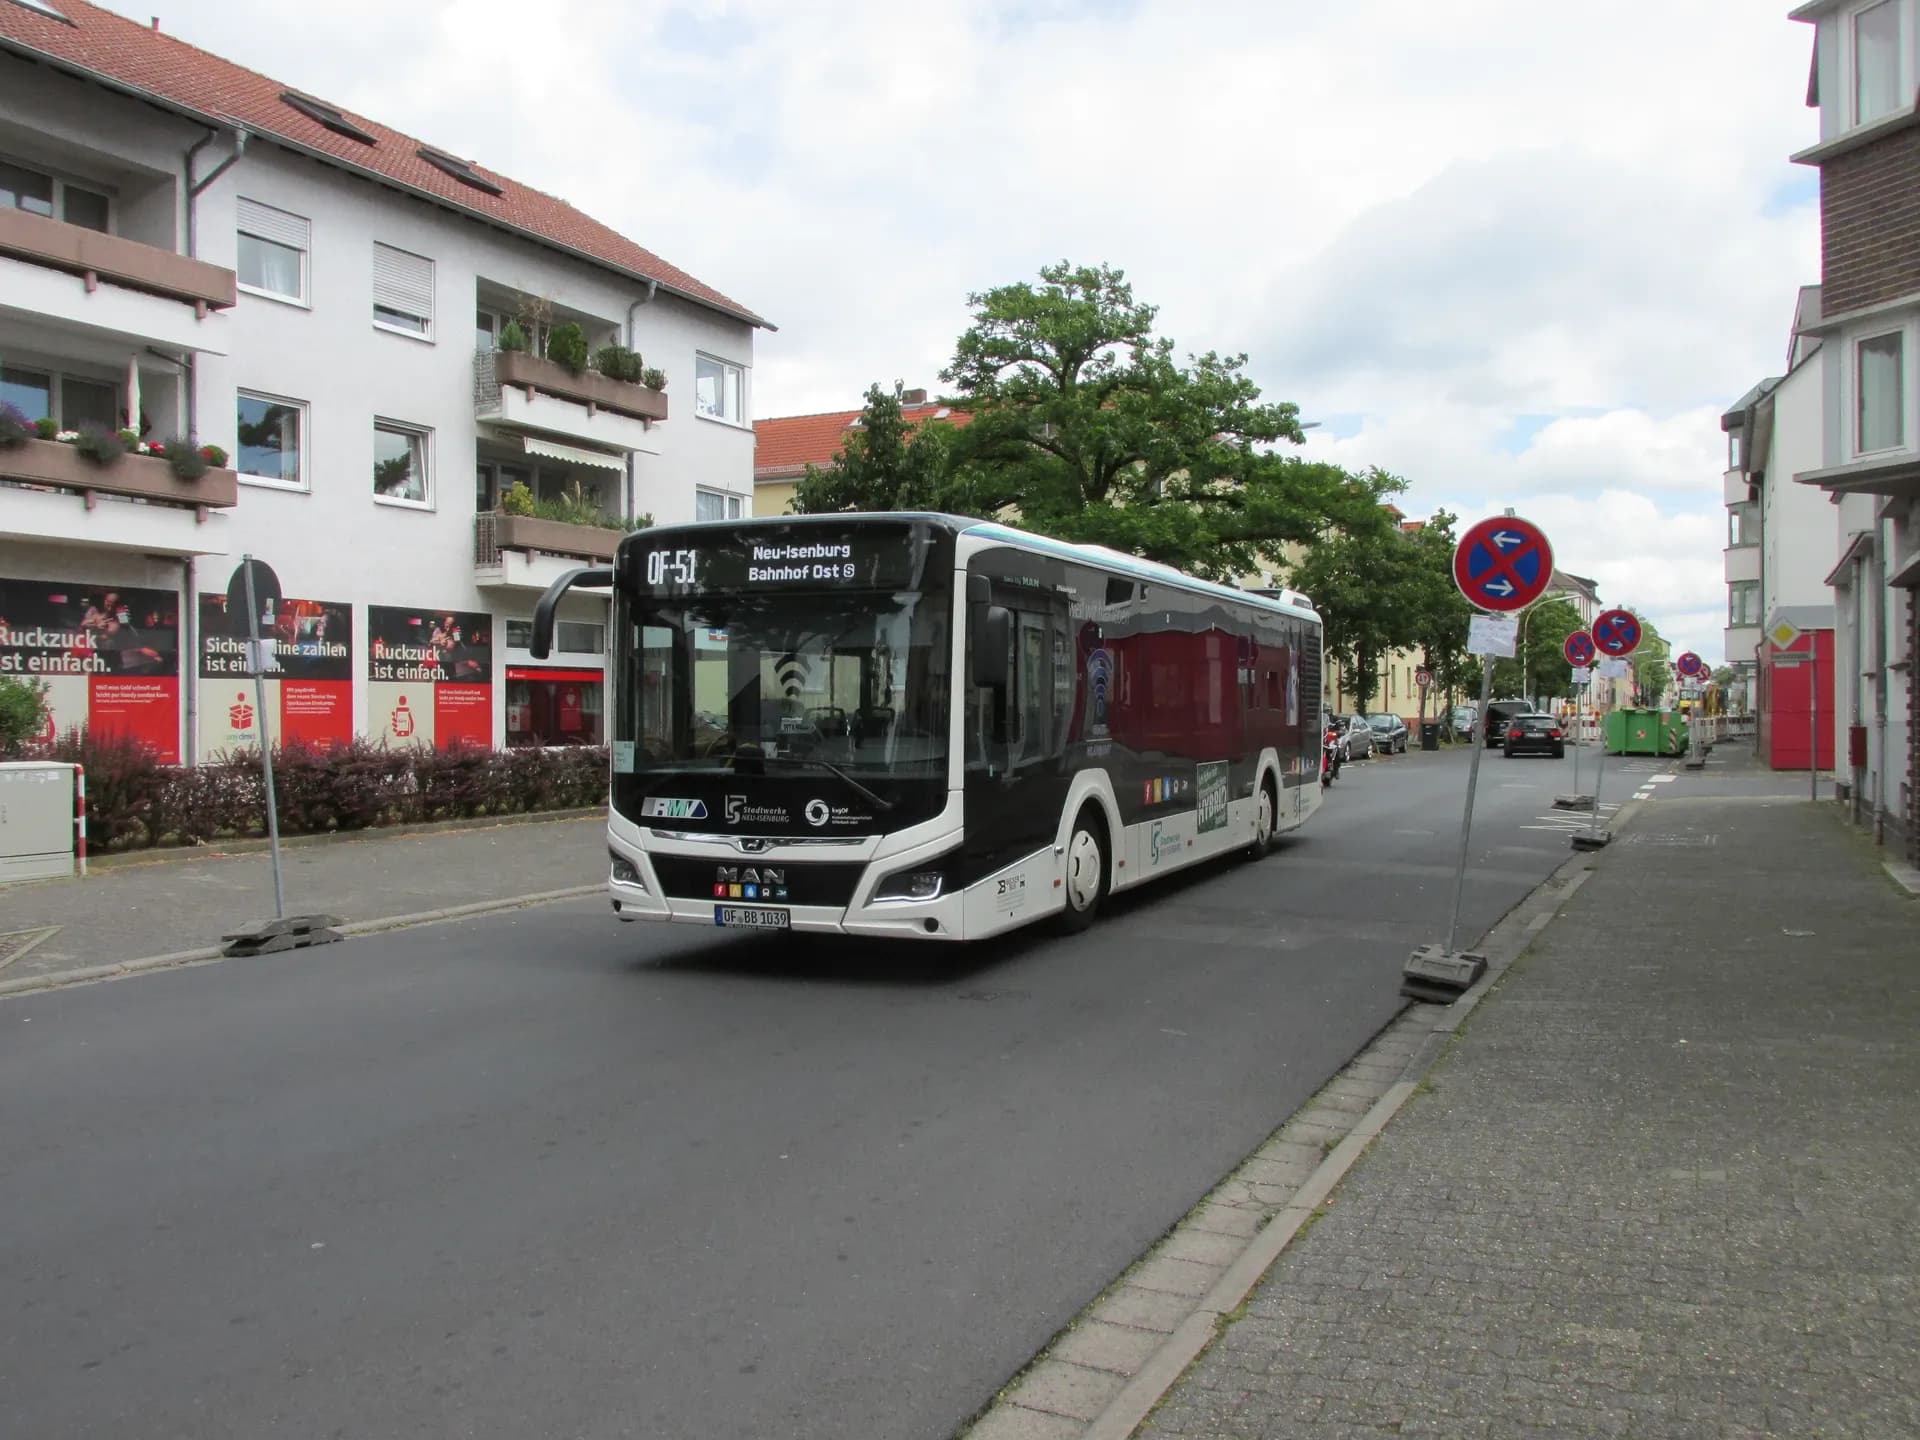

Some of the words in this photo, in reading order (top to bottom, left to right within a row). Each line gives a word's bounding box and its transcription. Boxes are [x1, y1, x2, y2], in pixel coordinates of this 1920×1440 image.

[753, 543, 850, 560] Neu-Isenburg
[647, 550, 696, 585] OF-51
[749, 564, 808, 581] Bahnhof
[813, 564, 839, 578] Ost
[0, 626, 97, 649] Ruckzuck
[303, 639, 347, 657] zahlen
[375, 643, 440, 661] Ruckzuck
[0, 651, 24, 671] st
[28, 651, 111, 673] einfach.
[206, 656, 226, 672] ist
[374, 662, 394, 679] ist
[396, 663, 449, 680] einfach.
[654, 799, 701, 818] RMV
[743, 806, 787, 815] Stadtwerke
[742, 813, 790, 823] NEU-ISENBURG
[716, 866, 784, 884] MAN
[724, 909, 737, 923] OF
[743, 910, 758, 924] BB
[760, 911, 787, 926] 1039
